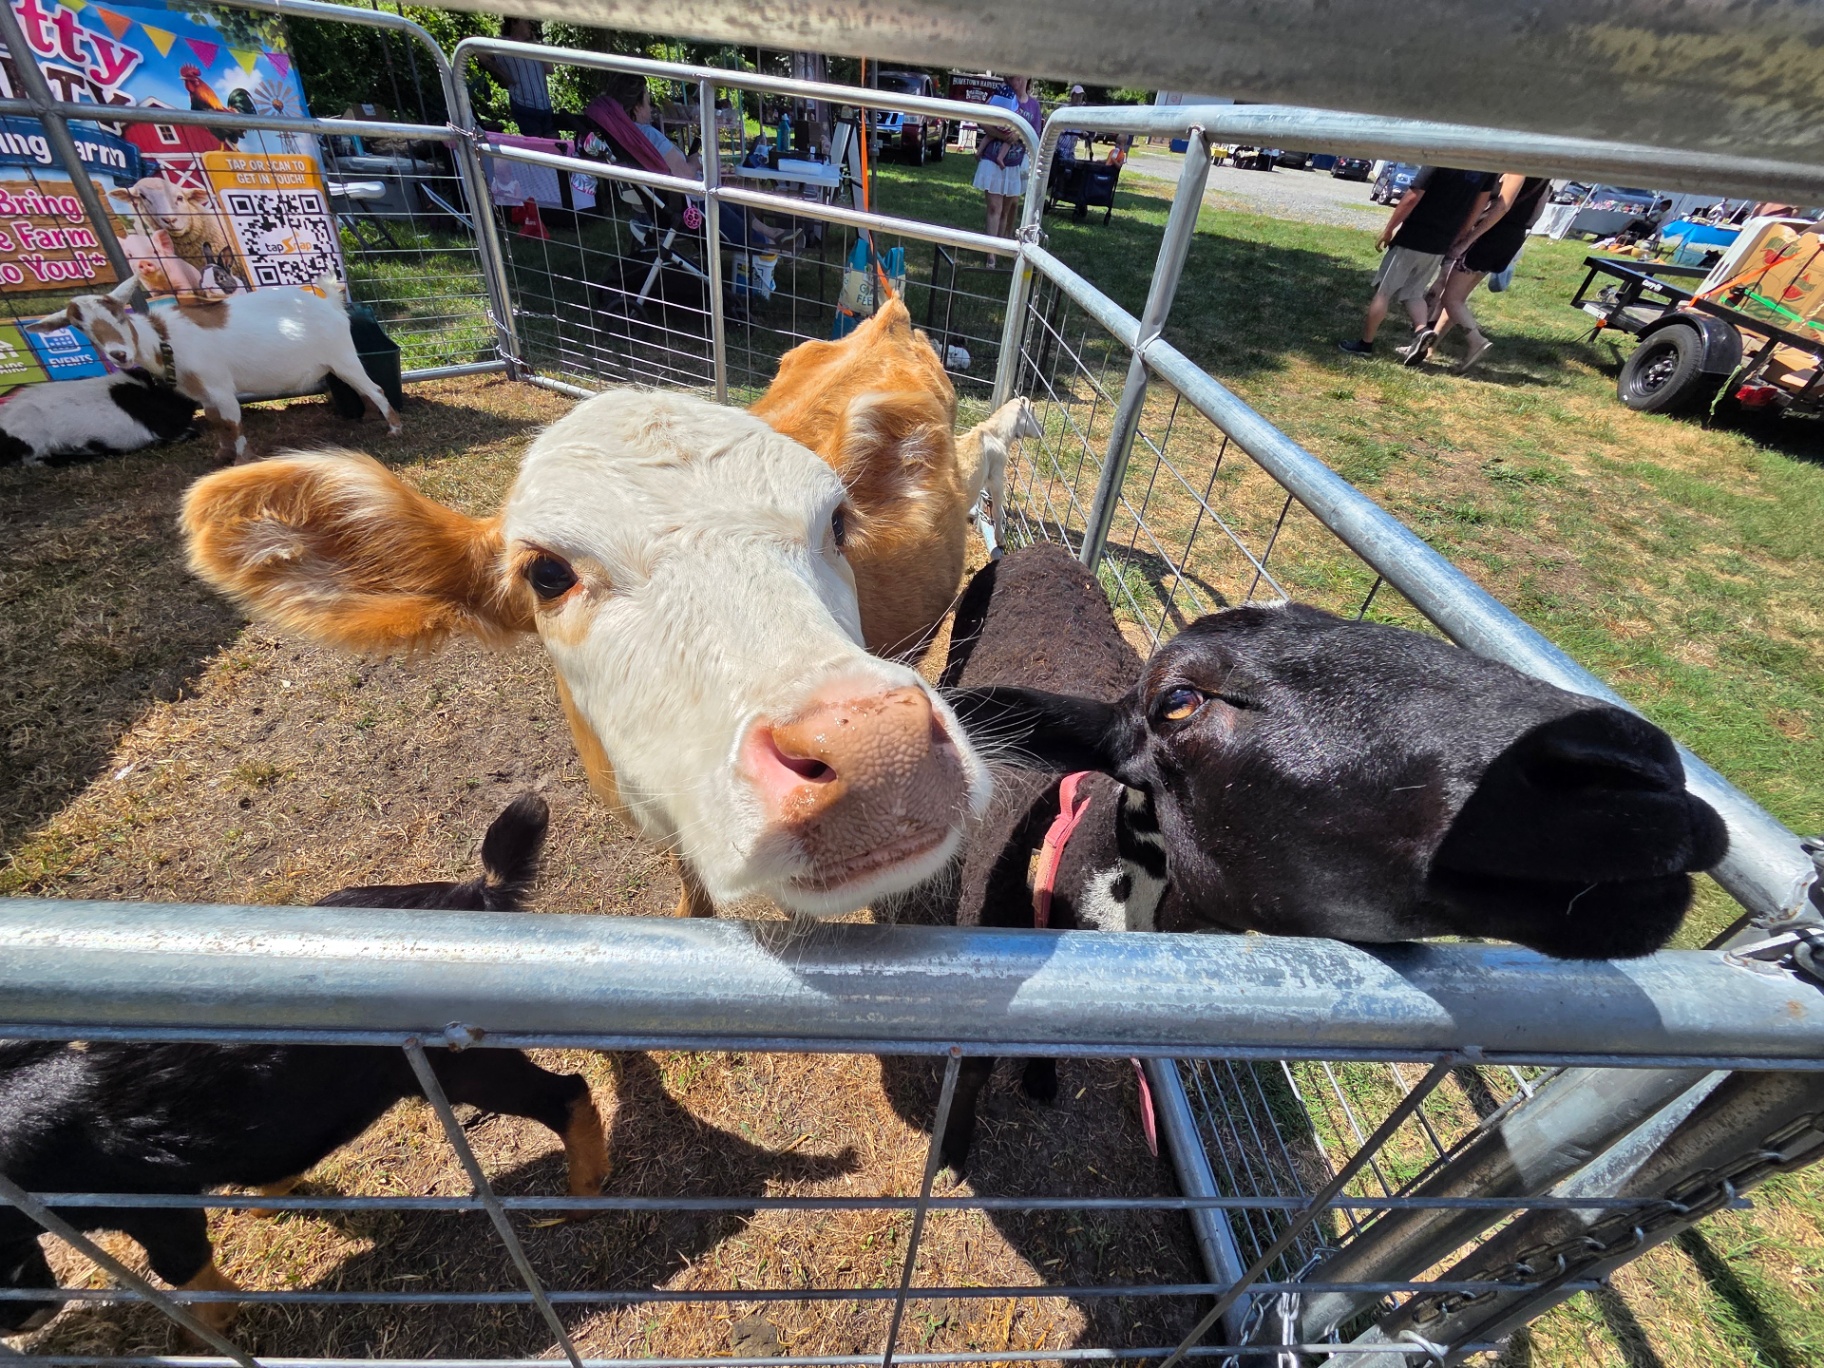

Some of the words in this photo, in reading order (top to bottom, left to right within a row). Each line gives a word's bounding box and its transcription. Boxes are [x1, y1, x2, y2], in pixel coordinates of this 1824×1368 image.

[75, 141, 126, 168] arm
[226, 159, 246, 170] TAP
[249, 160, 265, 171] OR
[292, 160, 305, 172] TO
[236, 172, 255, 184] GET
[260, 173, 270, 184] IN
[0, 188, 83, 222] Bring
[12, 222, 97, 250] Farm
[48, 354, 94, 368] EVENTS
